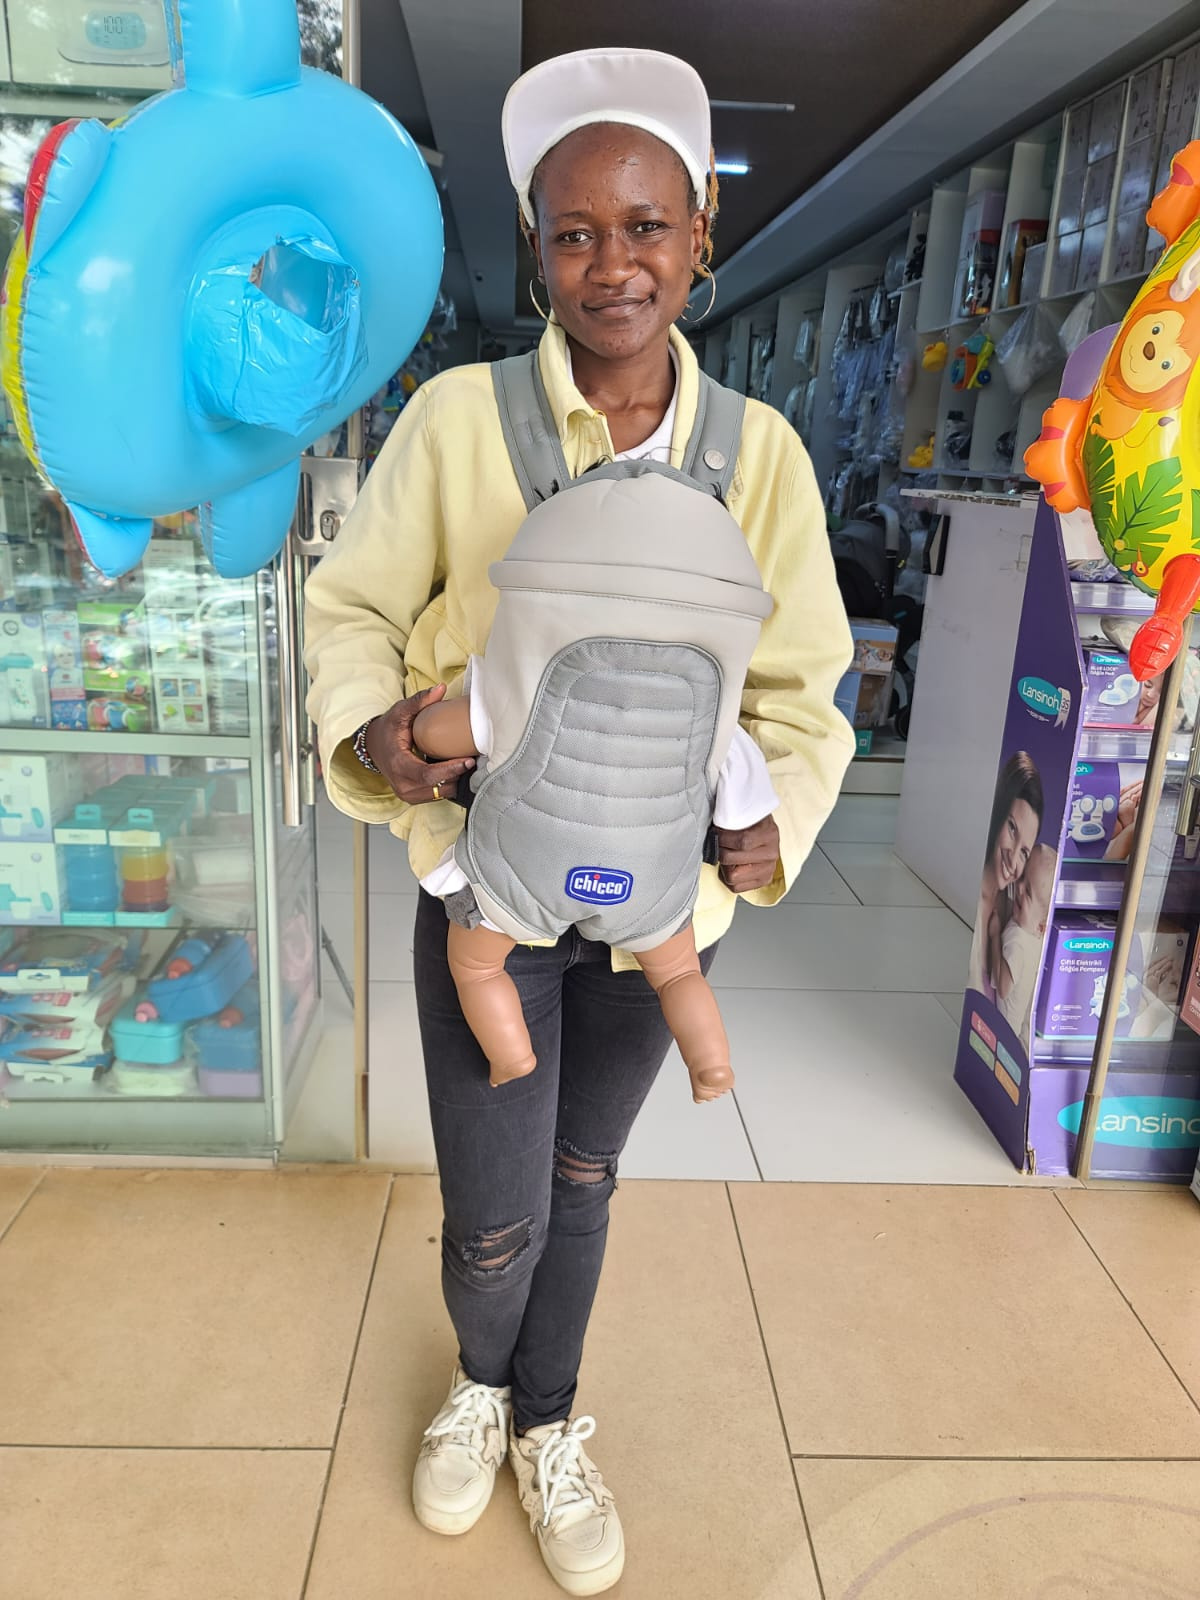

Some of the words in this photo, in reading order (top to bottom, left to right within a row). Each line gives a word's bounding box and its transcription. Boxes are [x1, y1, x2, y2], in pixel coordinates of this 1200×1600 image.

[103, 15, 123, 34] 100
[1022, 681, 1060, 711] Lansinoh
[1069, 941, 1110, 949] Lansinoh
